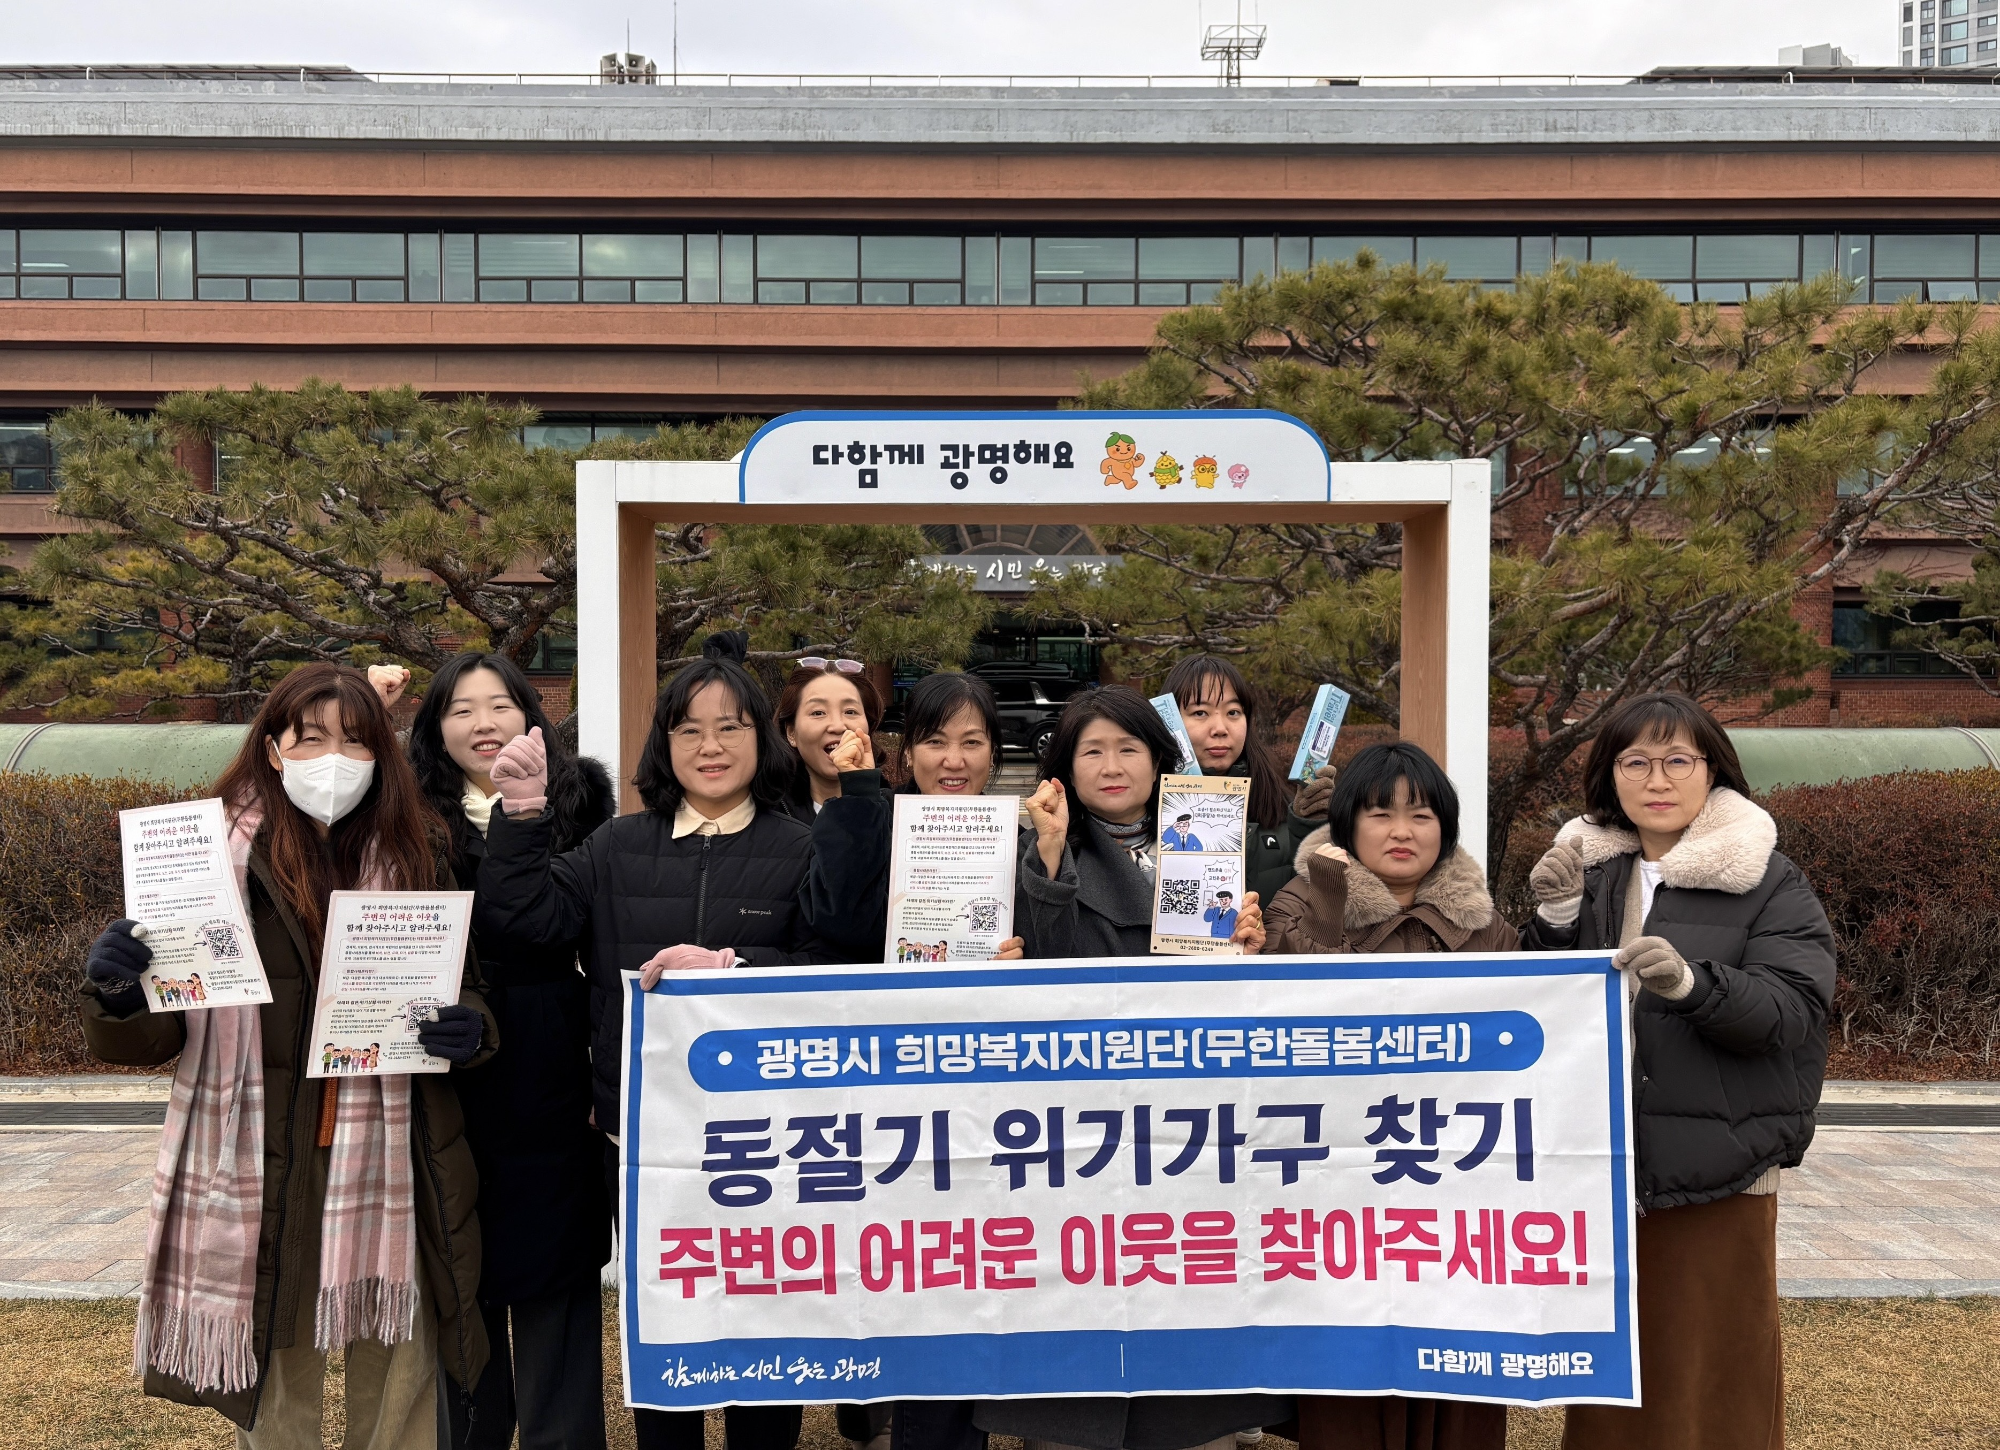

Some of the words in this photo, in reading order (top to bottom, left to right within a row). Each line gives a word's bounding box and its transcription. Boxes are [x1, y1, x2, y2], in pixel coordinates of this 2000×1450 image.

[812, 440, 925, 489] 다함께
[939, 440, 1075, 491] 광명해요
[986, 558, 1022, 582] 시민
[910, 824, 924, 833] 함께
[927, 824, 963, 833] 찾아주시고
[965, 824, 1002, 833] 알려주세요!
[922, 814, 944, 822] 주변의
[948, 814, 968, 822] 어려운
[970, 814, 991, 822] 이웃을
[346, 924, 363, 932] 함께
[366, 924, 407, 932] 찾아주시고
[409, 924, 452, 932] 알려주세요!
[362, 912, 386, 921] 주변의
[390, 912, 414, 921] 어려운
[416, 912, 440, 921] 이웃을
[756, 1036, 881, 1080] 광명시
[895, 1022, 1471, 1075] 희망복지지원단(무한돌봄센터)
[700, 1110, 951, 1208] 동절기
[990, 1103, 1330, 1192] 위기가구
[1363, 1093, 1534, 1186] 찾기
[659, 1223, 837, 1299] 주변의
[859, 1216, 1037, 1293] 어려운
[1060, 1210, 1239, 1287] 이웃을
[1260, 1206, 1589, 1287] 찾아주세요!
[661, 1356, 740, 1388] 함께하는
[741, 1355, 784, 1381] 시민
[786, 1356, 828, 1385] 웃는
[830, 1356, 881, 1382] 광명
[1417, 1347, 1493, 1376] 다함께
[1500, 1352, 1594, 1379] 광명해요
